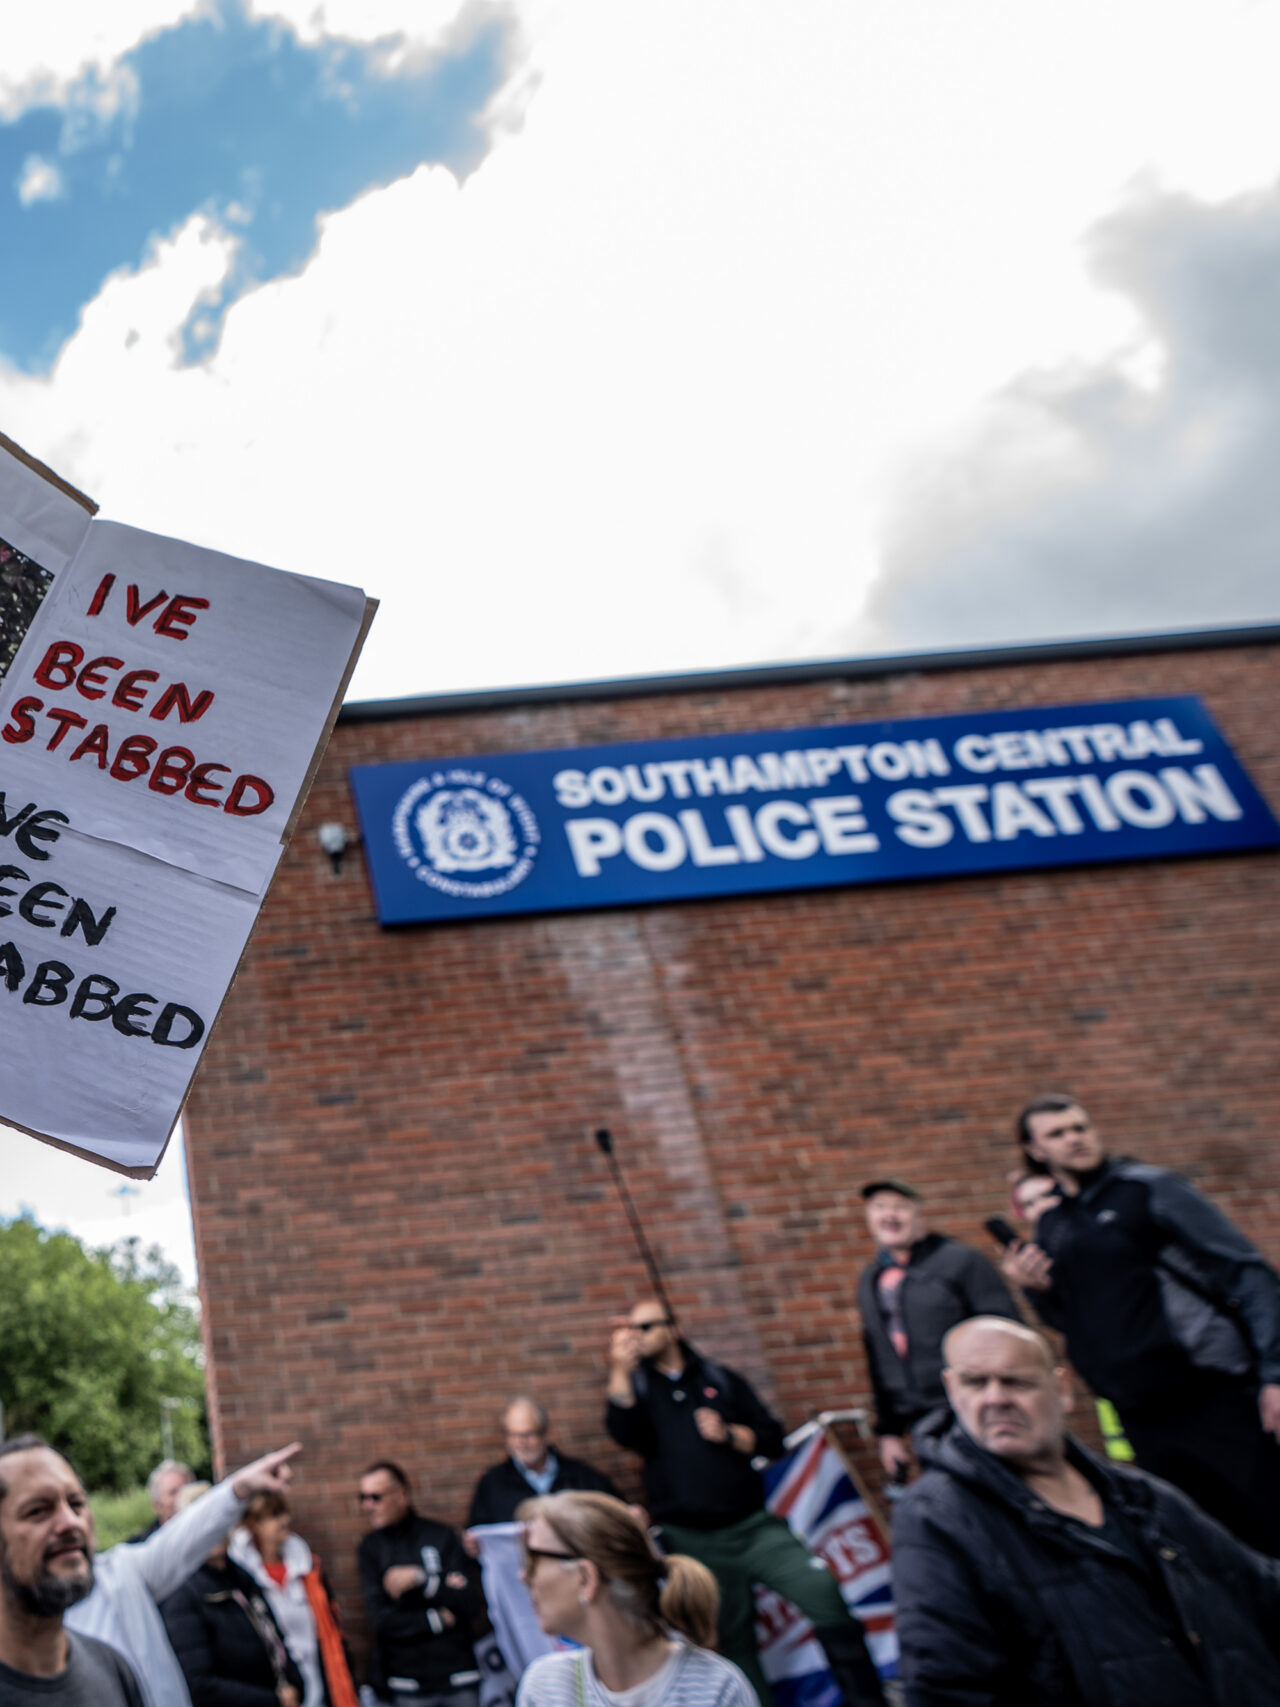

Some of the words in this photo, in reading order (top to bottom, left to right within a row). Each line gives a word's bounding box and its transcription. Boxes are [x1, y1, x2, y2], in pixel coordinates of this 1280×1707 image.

[32, 640, 216, 724] BEEN
[0, 695, 275, 817] STABBED
[552, 740, 950, 808] SOUTHAMPTON
[954, 718, 1203, 774] CENTRAL
[564, 796, 880, 877] POLICE
[886, 763, 1243, 849] STATION
